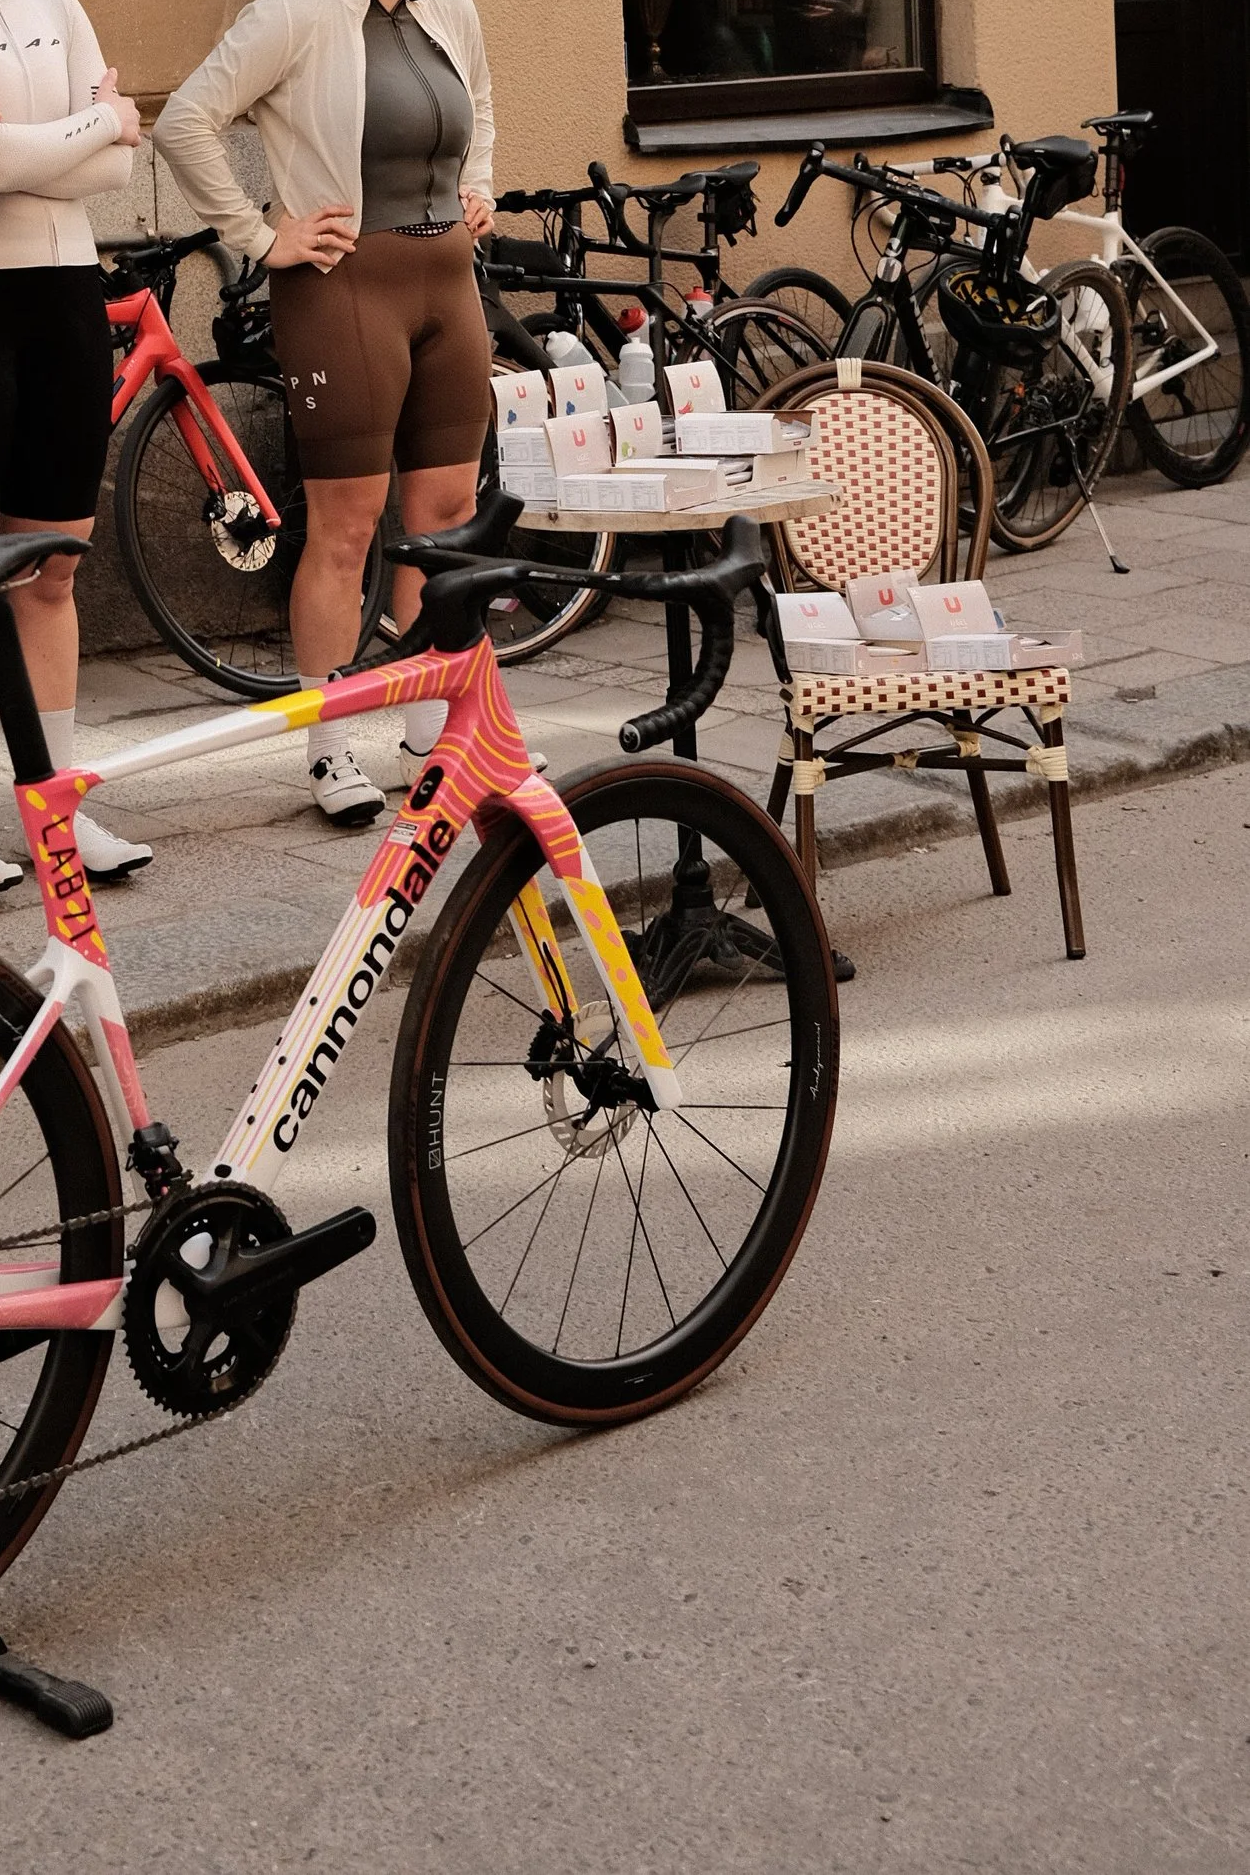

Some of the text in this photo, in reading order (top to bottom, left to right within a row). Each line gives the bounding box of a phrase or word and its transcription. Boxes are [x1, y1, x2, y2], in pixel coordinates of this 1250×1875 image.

[41, 815, 96, 943] LAB71
[273, 818, 455, 1153] cannondale
[428, 1071, 444, 1146] HUNT
